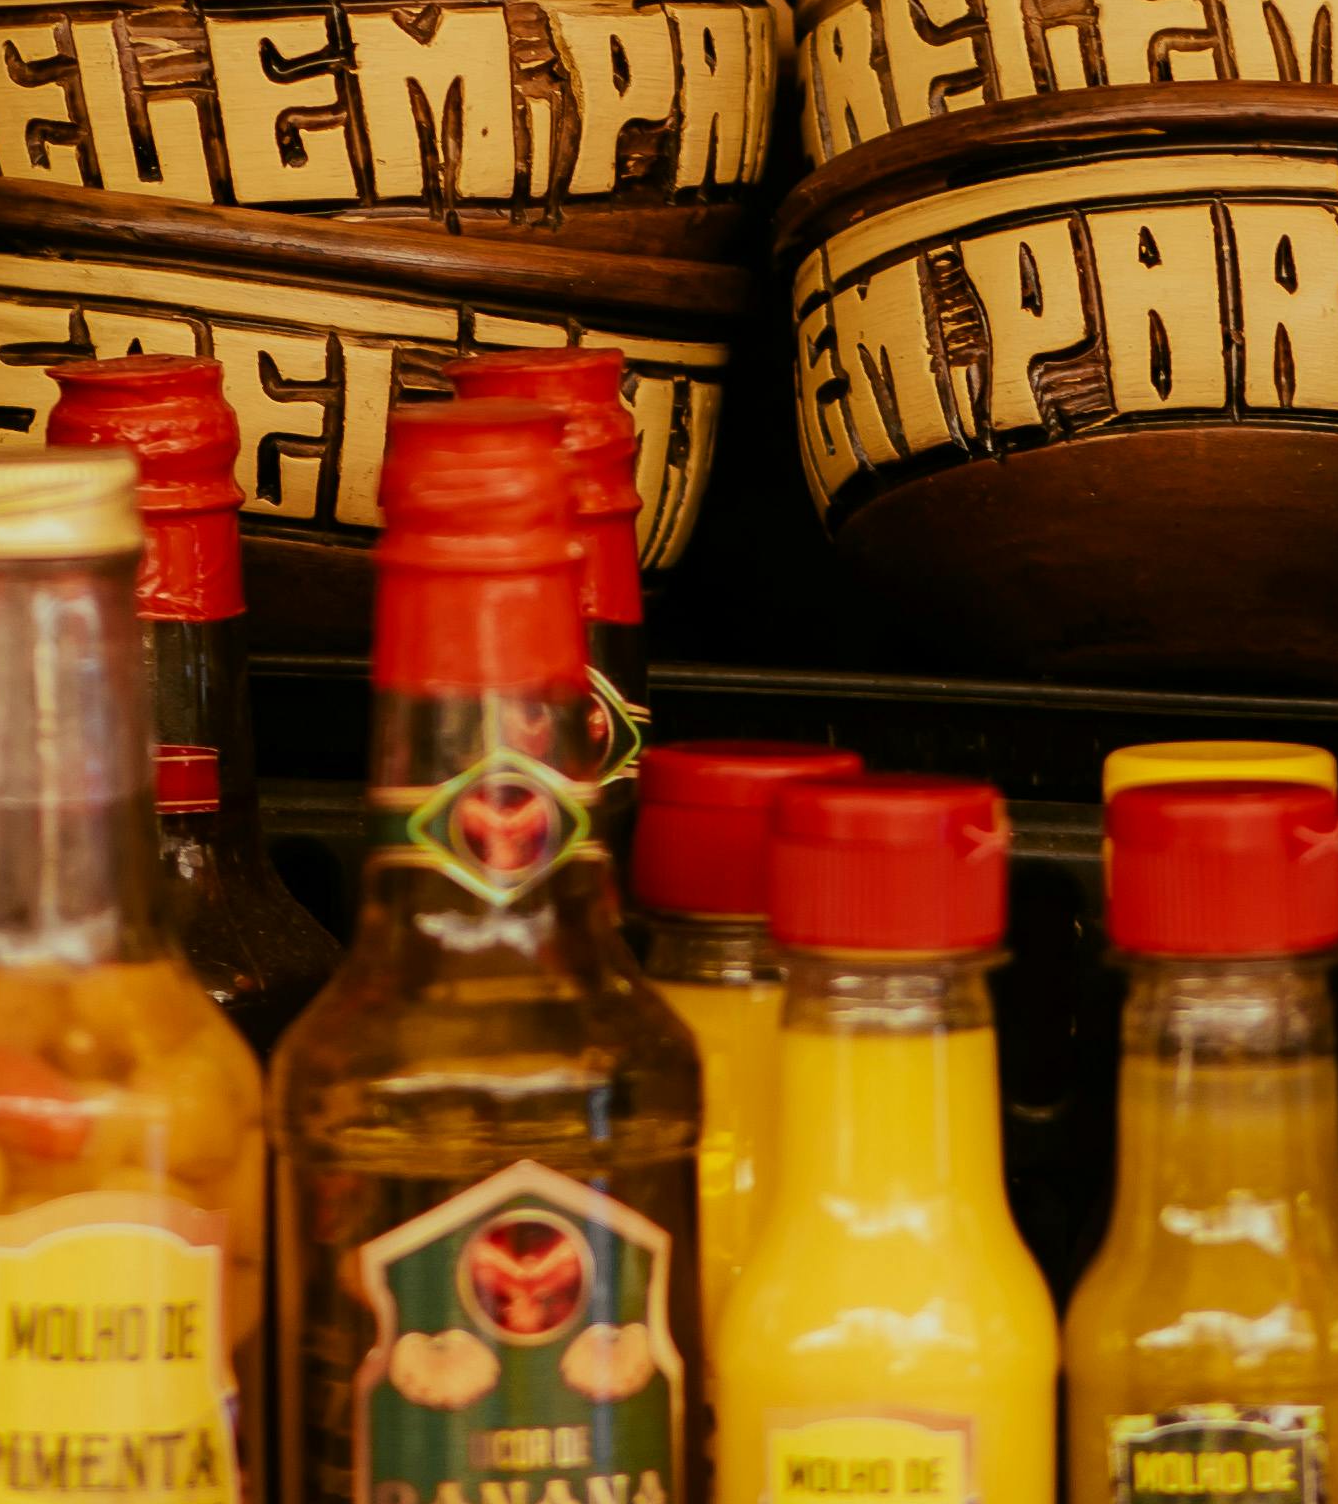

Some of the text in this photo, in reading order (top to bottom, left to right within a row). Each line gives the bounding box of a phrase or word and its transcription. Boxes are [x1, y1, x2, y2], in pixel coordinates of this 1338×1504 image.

[7, 1302, 202, 1362] MOLHO DE
[785, 1456, 943, 1495] MOLHO DE
[1133, 1448, 1298, 1495] MOLHO DE
